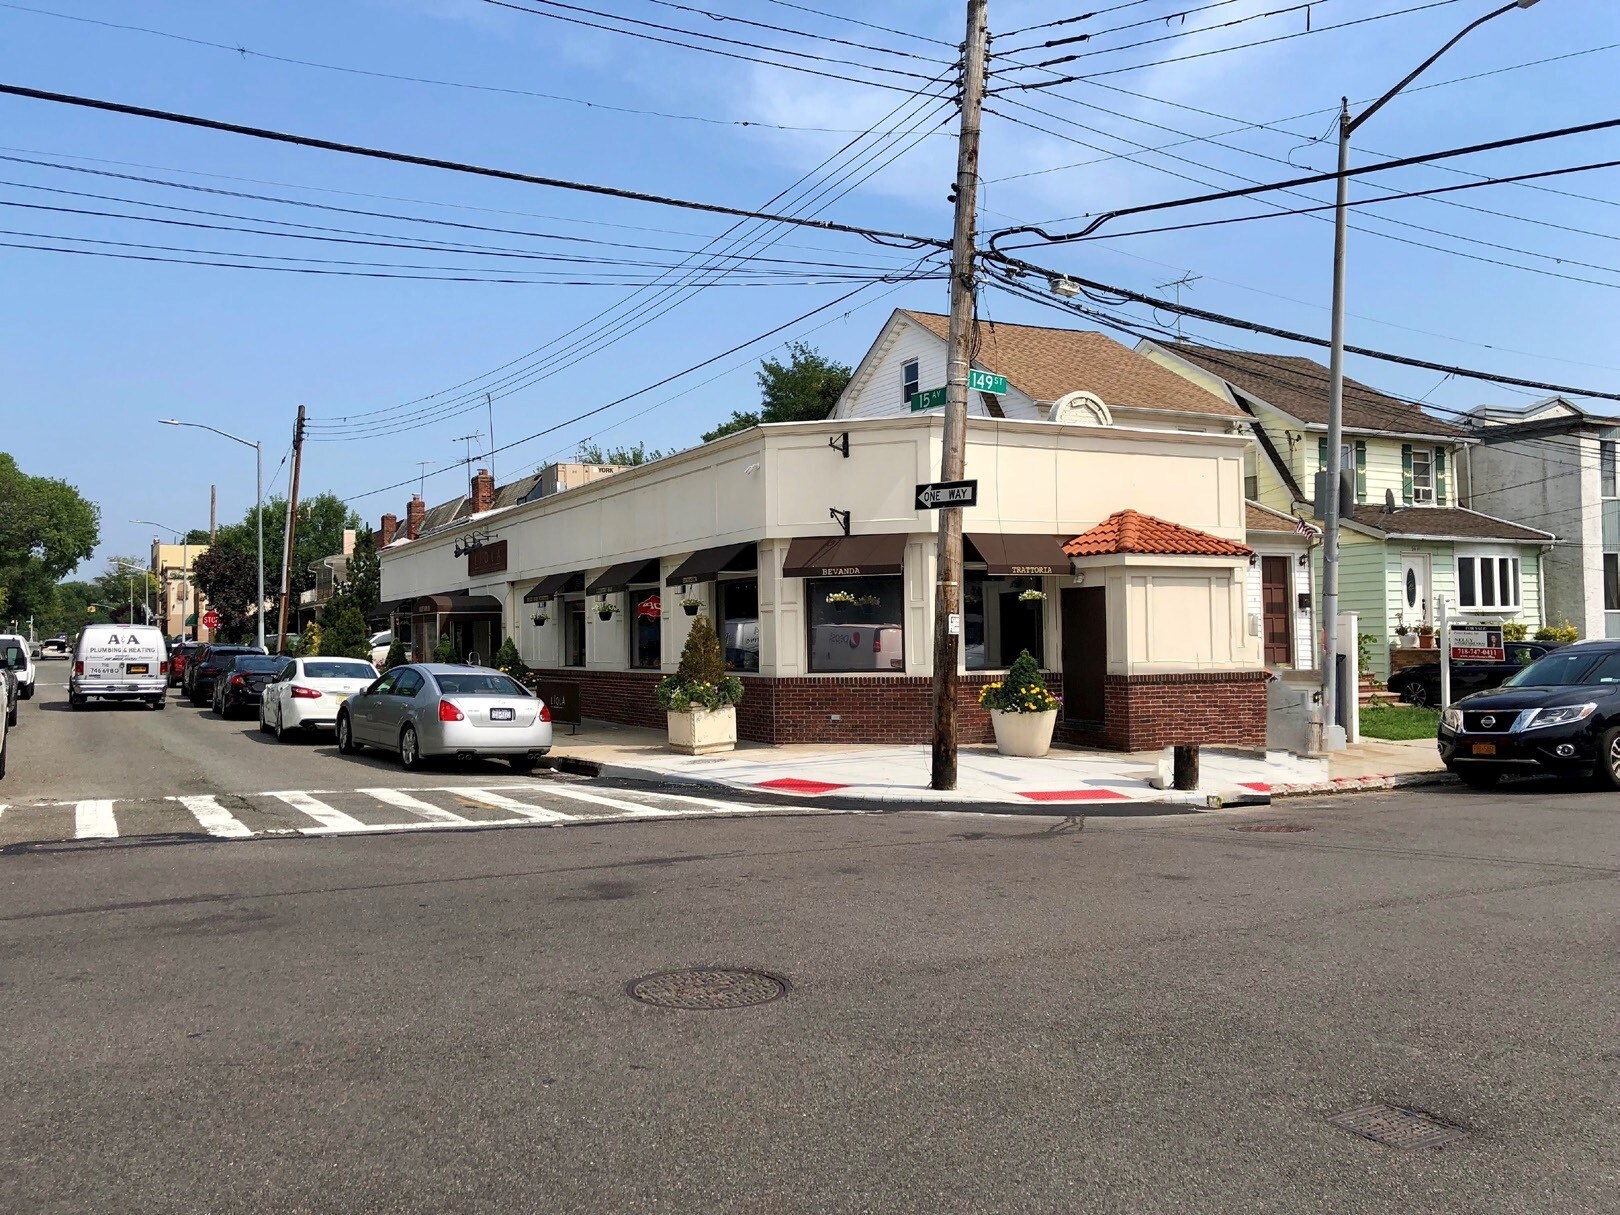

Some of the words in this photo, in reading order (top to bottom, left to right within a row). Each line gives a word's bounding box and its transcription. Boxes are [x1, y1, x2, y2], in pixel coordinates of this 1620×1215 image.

[972, 372, 993, 390] 149
[994, 376, 1004, 386] ST
[919, 392, 931, 408] 15
[932, 390, 941, 399] AV
[923, 490, 941, 502] ONE
[948, 488, 968, 500] WAY
[821, 567, 861, 576] BEVANDA
[1011, 566, 1053, 574] TRATTORIA
[108, 634, 120, 644] A
[127, 634, 140, 644] A
[1457, 648, 1497, 656] 718-747-0411
